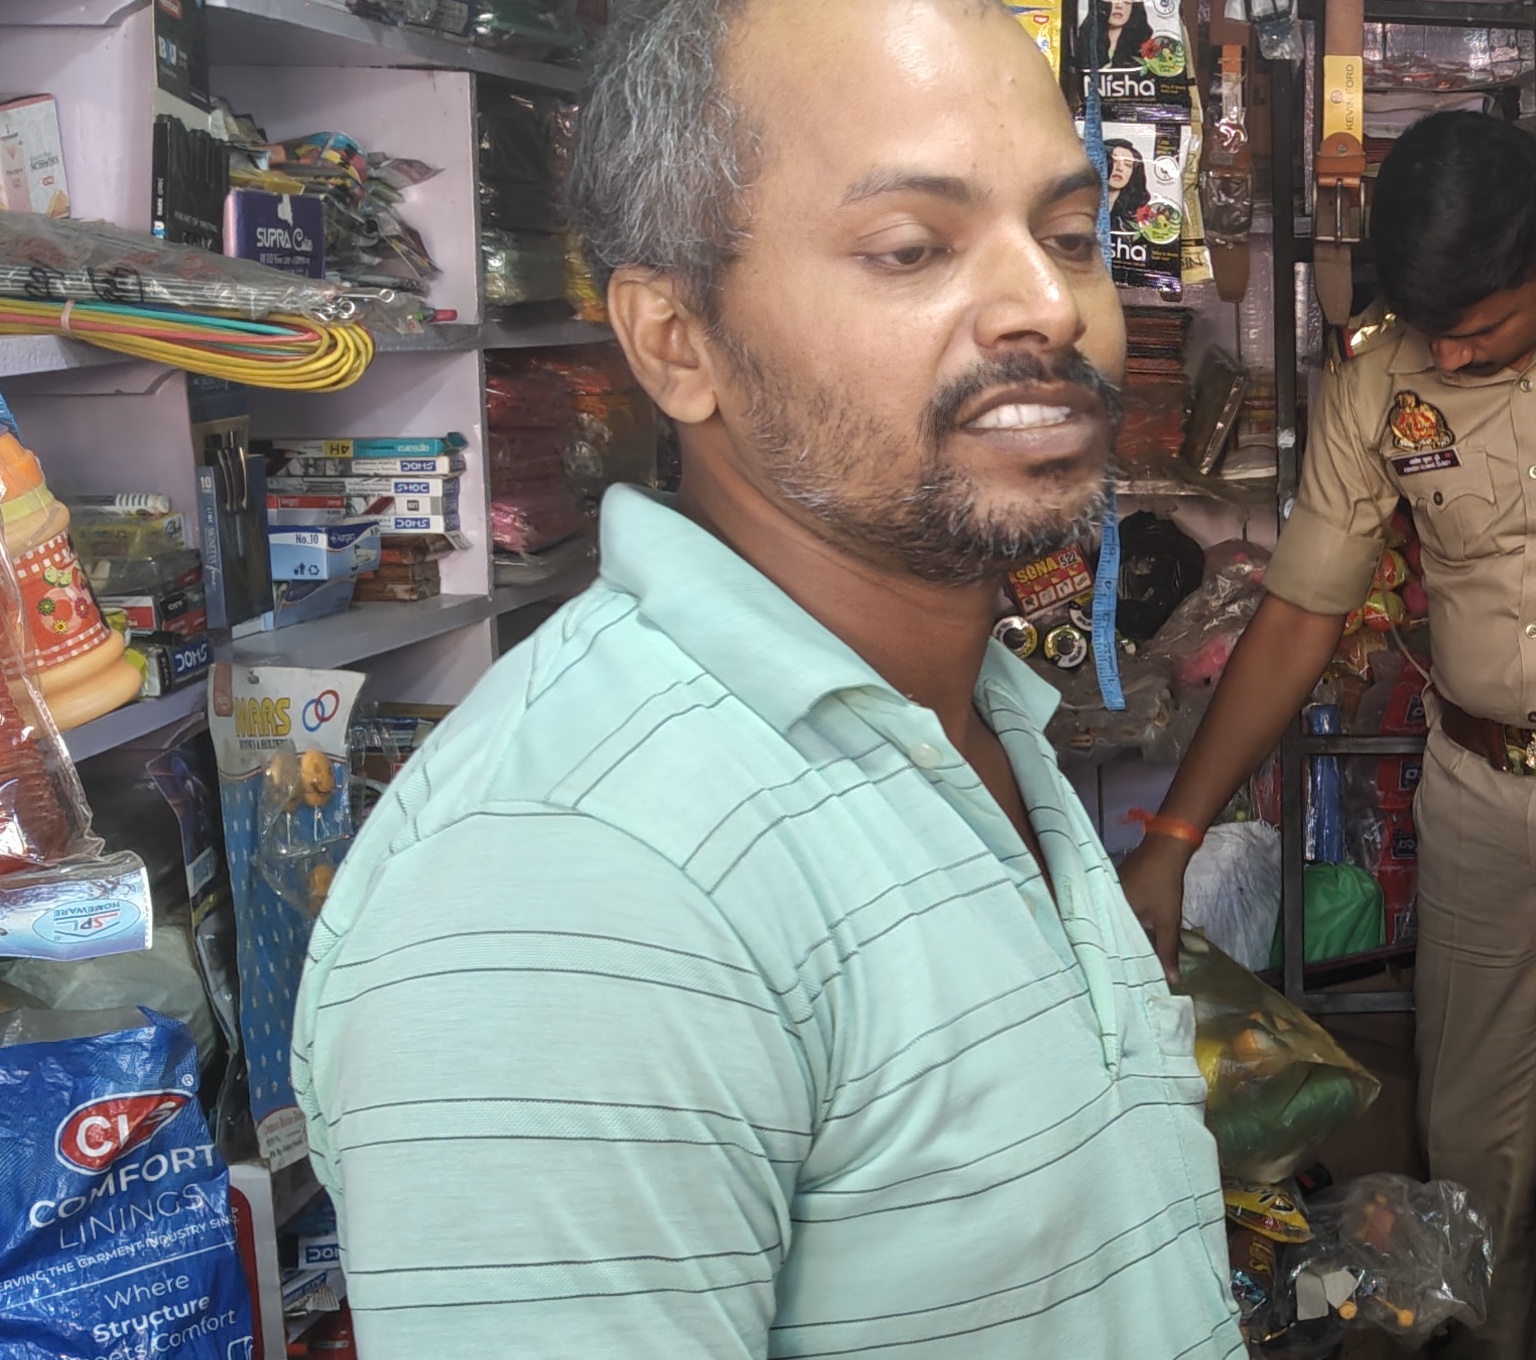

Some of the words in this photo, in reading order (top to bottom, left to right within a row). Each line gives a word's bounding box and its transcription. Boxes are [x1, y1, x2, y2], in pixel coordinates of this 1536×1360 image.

[1083, 72, 1156, 99] Nisha
[1345, 64, 1355, 96] FORD
[1345, 98, 1355, 131] KEVIN
[256, 227, 291, 247] SUPRA
[1015, 556, 1061, 583] SONA
[1058, 550, 1080, 569] 522
[234, 697, 292, 738] MAAS
[54, 901, 120, 917] HOMEWARE
[29, 1143, 215, 1229] COMFORT
[59, 1183, 205, 1250] LININGS
[48, 1261, 76, 1278] THE
[76, 1241, 141, 1270] GARMENT
[103, 1273, 191, 1310] Where
[92, 1296, 210, 1344] Structure
[150, 1309, 237, 1353] Comfort
